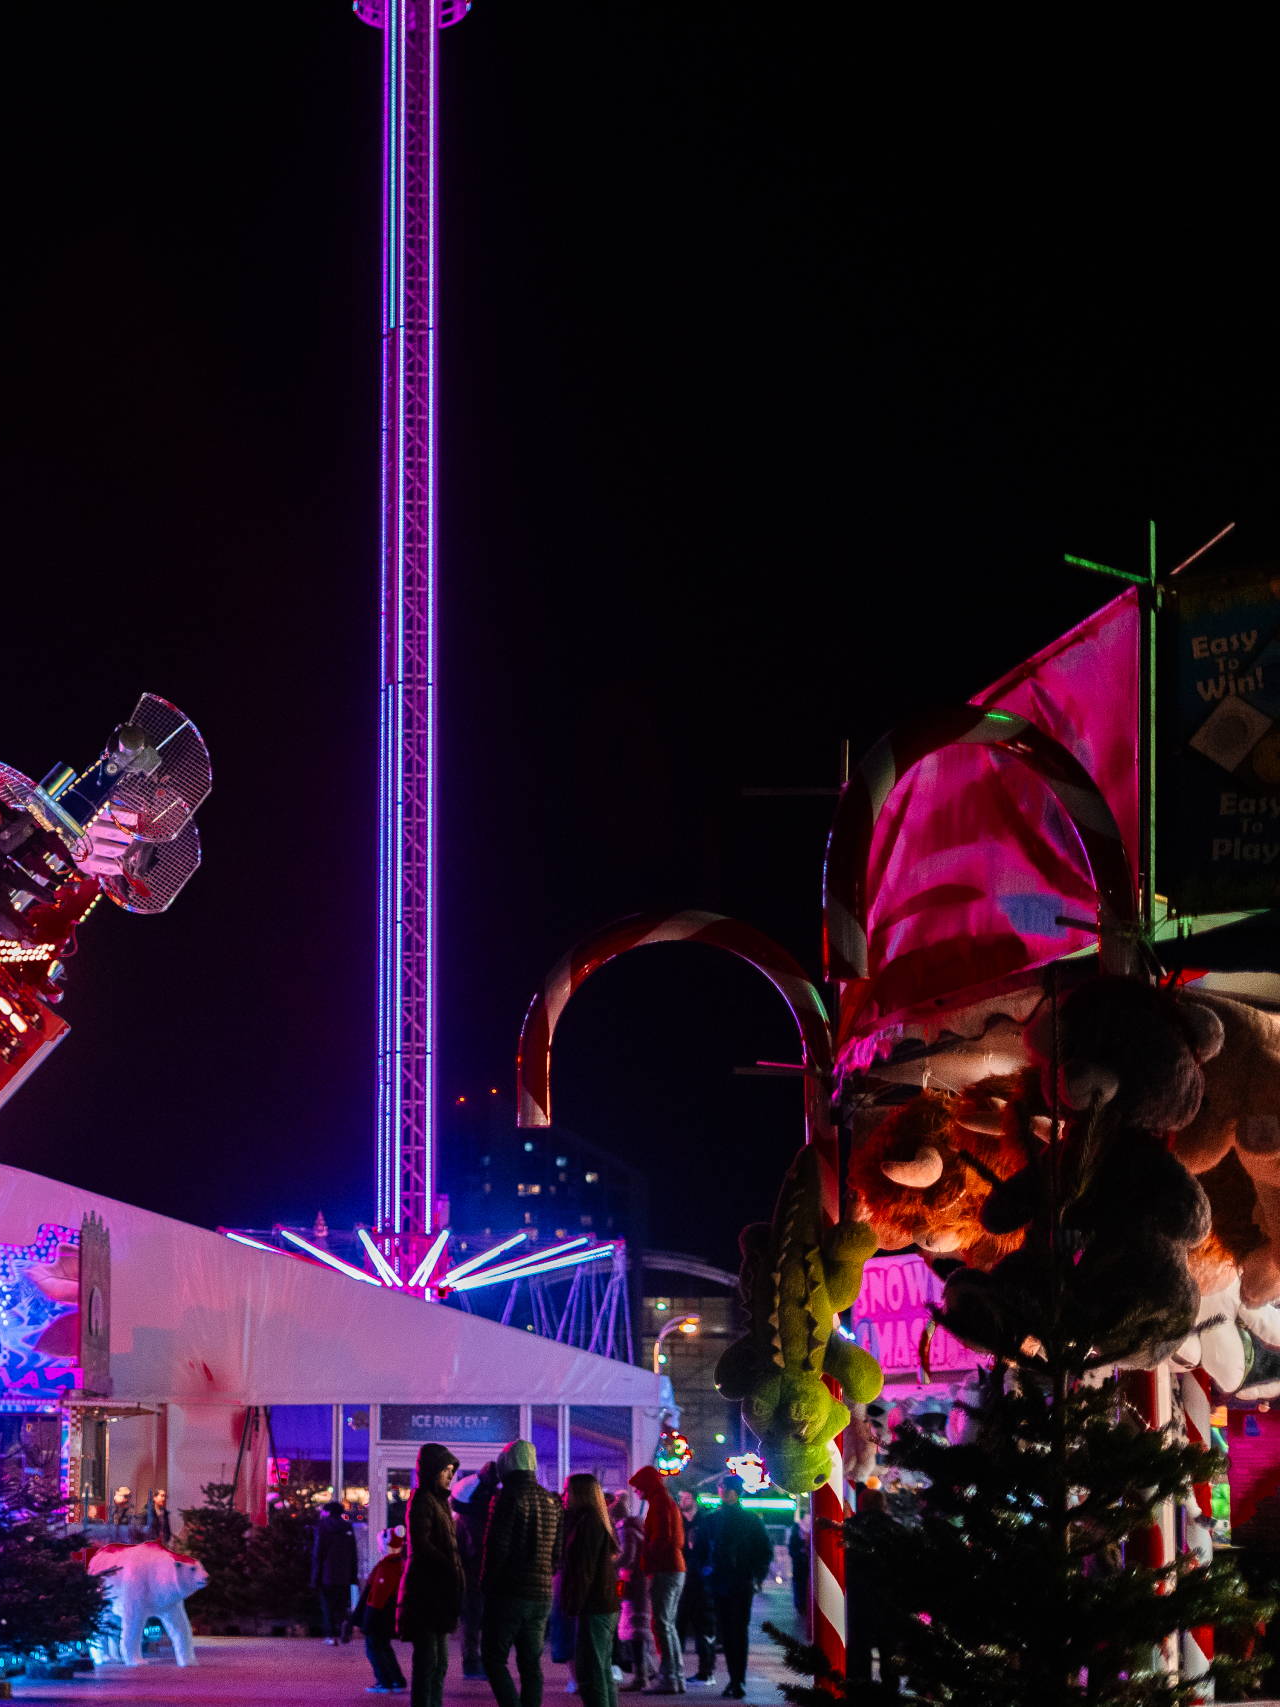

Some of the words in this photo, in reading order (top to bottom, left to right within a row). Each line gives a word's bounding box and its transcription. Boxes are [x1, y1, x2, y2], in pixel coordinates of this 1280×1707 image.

[1191, 629, 1258, 660] Easy
[1215, 656, 1240, 674] To
[1196, 666, 1264, 702] Win!
[1220, 792, 1280, 818] Easy
[1241, 817, 1263, 834] To
[1212, 837, 1280, 865] Play
[411, 1415, 432, 1428] ICE
[434, 1415, 462, 1428] RINK
